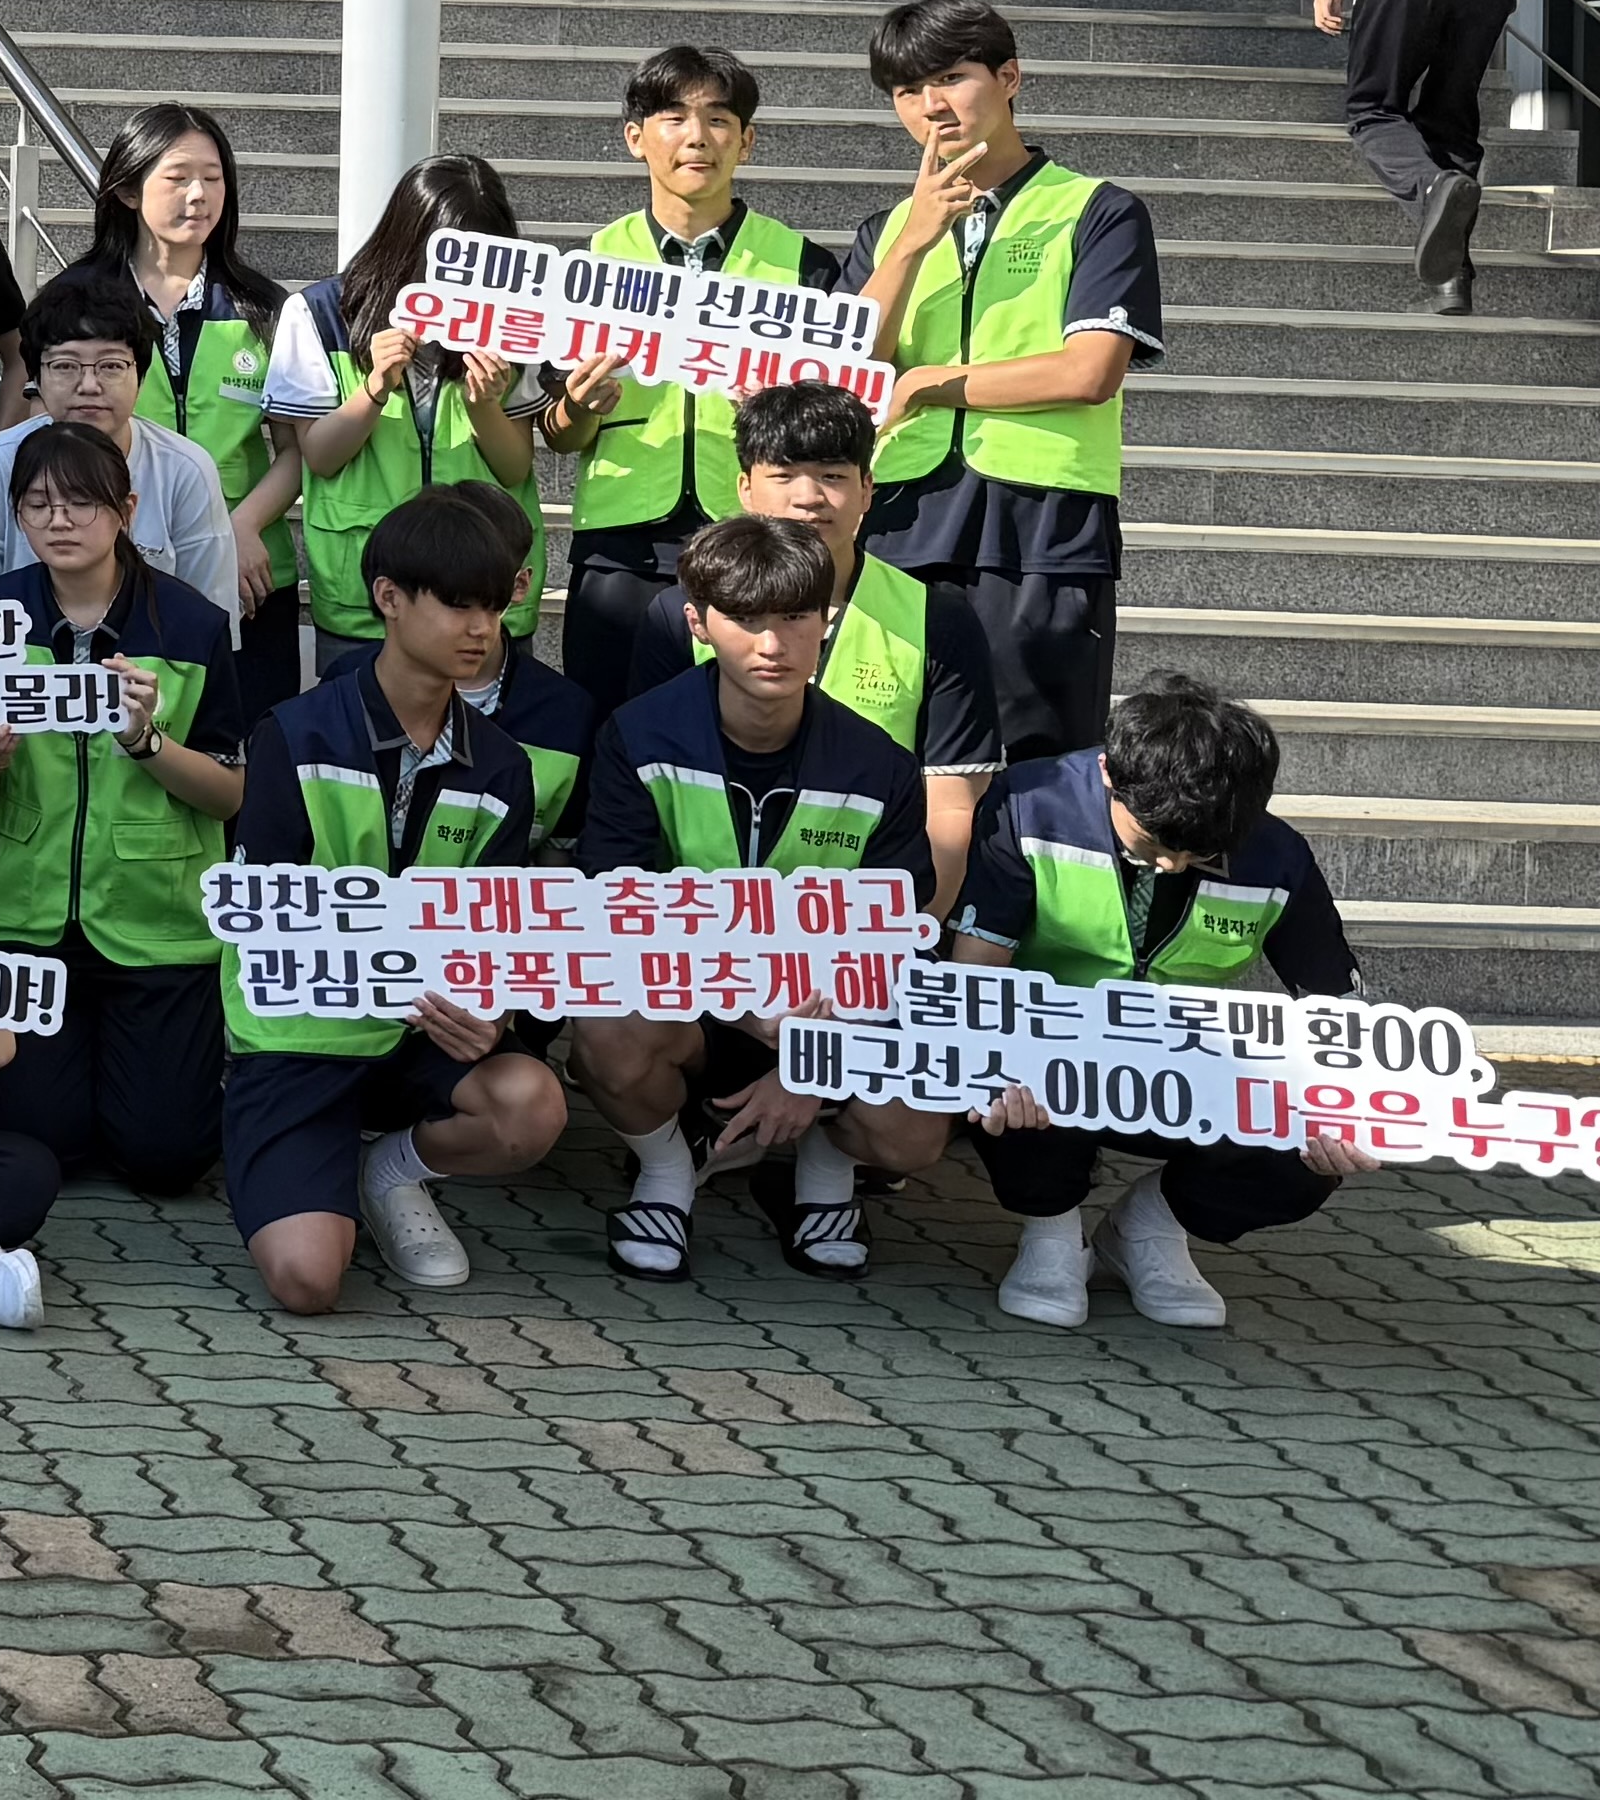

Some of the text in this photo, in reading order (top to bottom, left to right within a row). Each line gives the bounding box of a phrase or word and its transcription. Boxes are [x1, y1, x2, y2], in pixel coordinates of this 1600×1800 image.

[398, 291, 547, 355] 우리를
[560, 316, 662, 377] 지켜
[435, 236, 872, 352] 엄마! 아빠! 선생님!
[1, 674, 121, 725] 몰라!
[208, 873, 930, 940] 칭찬은 고래도 춤추게 하고,
[246, 949, 424, 1008] 관심은
[440, 949, 622, 1011] 학폭도
[642, 951, 813, 1011] 멈추게
[905, 968, 1085, 1042] 불타는
[1101, 990, 1285, 1062] 트롯맨
[790, 1027, 1022, 1106] 배구선수
[1235, 1076, 1428, 1150] 다음은
